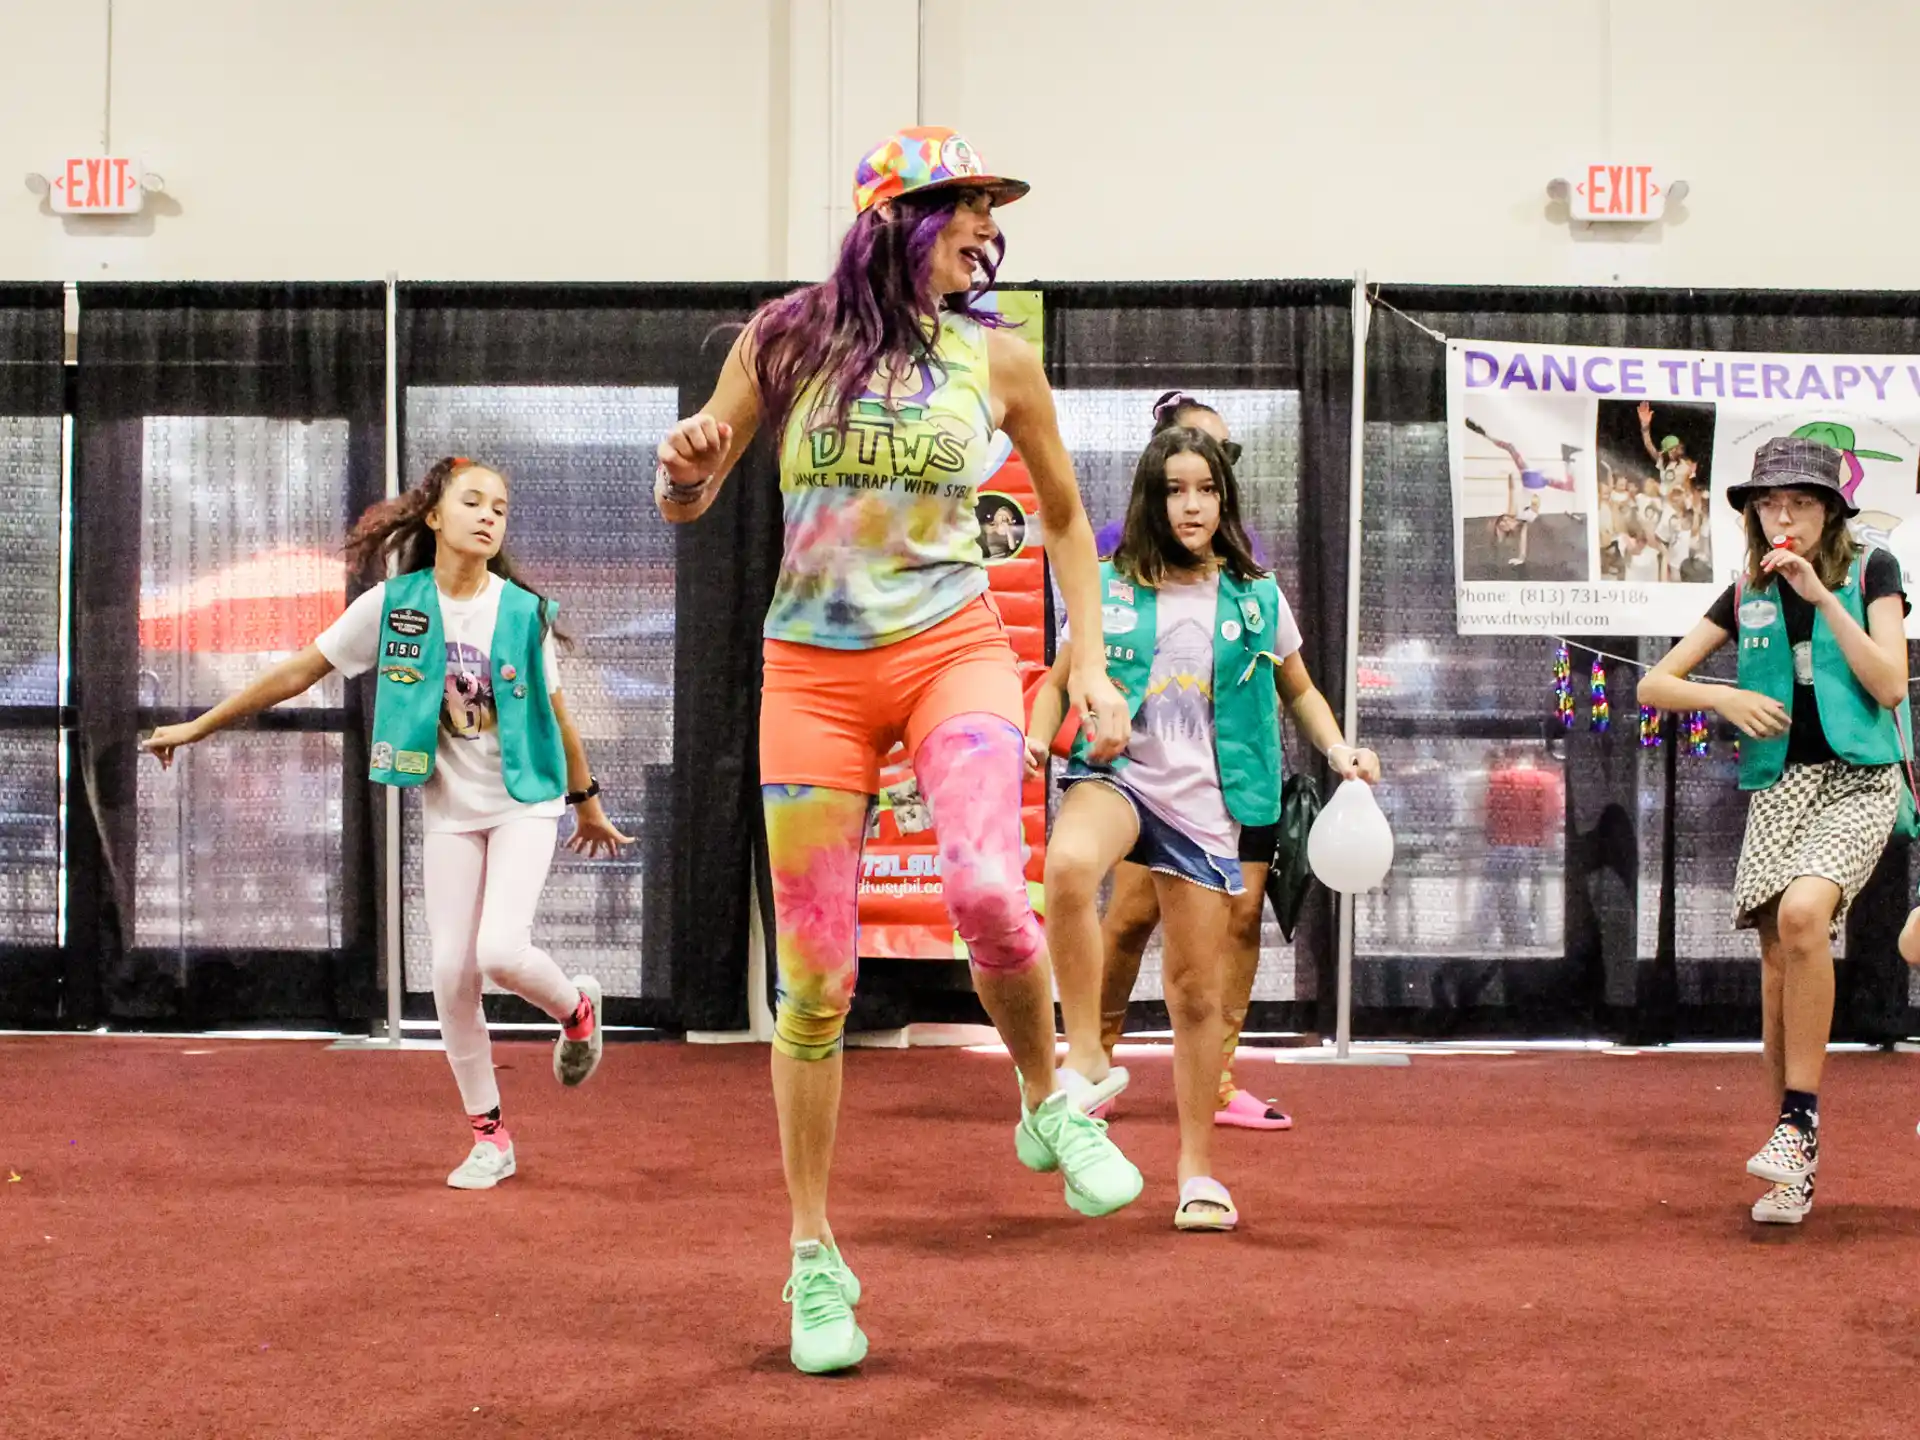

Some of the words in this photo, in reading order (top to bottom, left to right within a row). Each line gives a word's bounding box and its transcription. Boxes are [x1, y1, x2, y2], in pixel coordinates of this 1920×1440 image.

[66, 158, 129, 207] EXIT
[1588, 165, 1652, 214] EXIT
[1465, 351, 1647, 394] DANCE
[1658, 360, 1895, 400] THERAPY
[811, 419, 968, 477] DTWS
[836, 473, 898, 492] THERAPY
[904, 478, 939, 495] WITH
[1520, 588, 1564, 606] (813)
[1571, 588, 1649, 604] 731-9186
[388, 642, 419, 656] 150
